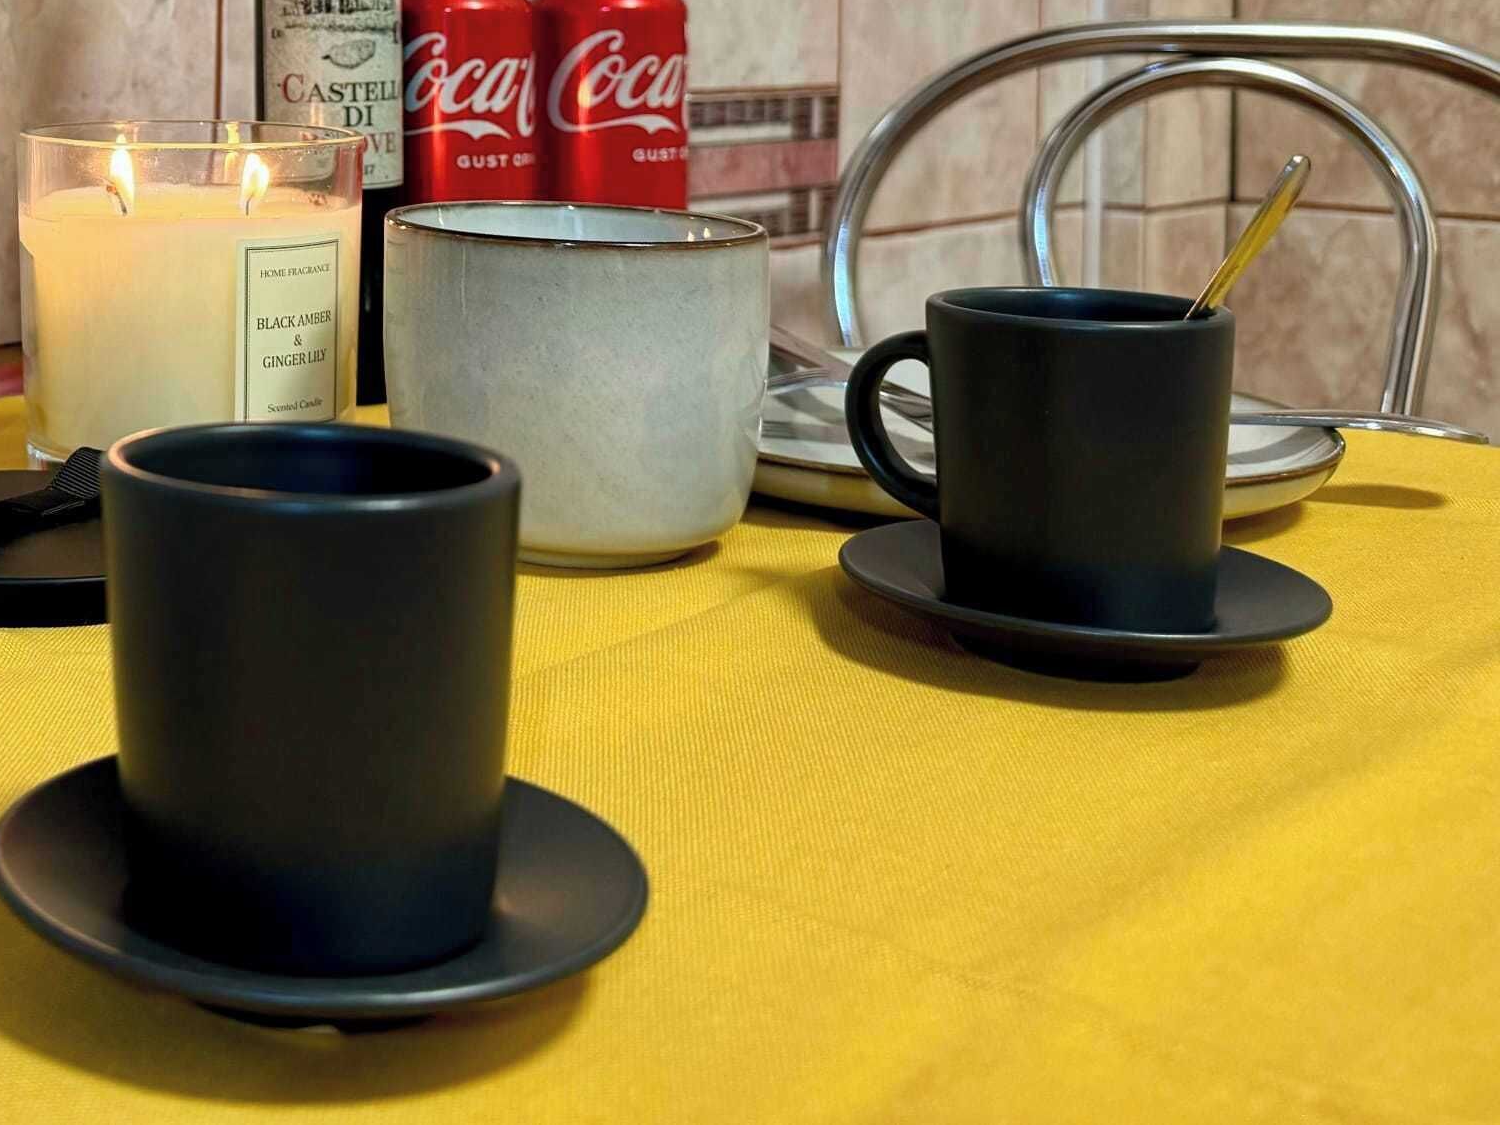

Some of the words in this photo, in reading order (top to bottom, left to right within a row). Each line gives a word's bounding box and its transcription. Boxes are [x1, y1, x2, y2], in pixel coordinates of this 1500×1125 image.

[343, 105, 374, 126] DI
[456, 154, 509, 169] GUST
[632, 147, 677, 162] GUST
[260, 268, 286, 278] HOME
[287, 263, 330, 277] FRAGRANCE
[257, 315, 295, 330] BLACK
[297, 309, 332, 327] AMBER
[293, 333, 303, 347] &
[262, 352, 307, 369] GINGER
[308, 347, 327, 364] LILY
[267, 402, 299, 413] Scented
[299, 397, 324, 409] Candle
